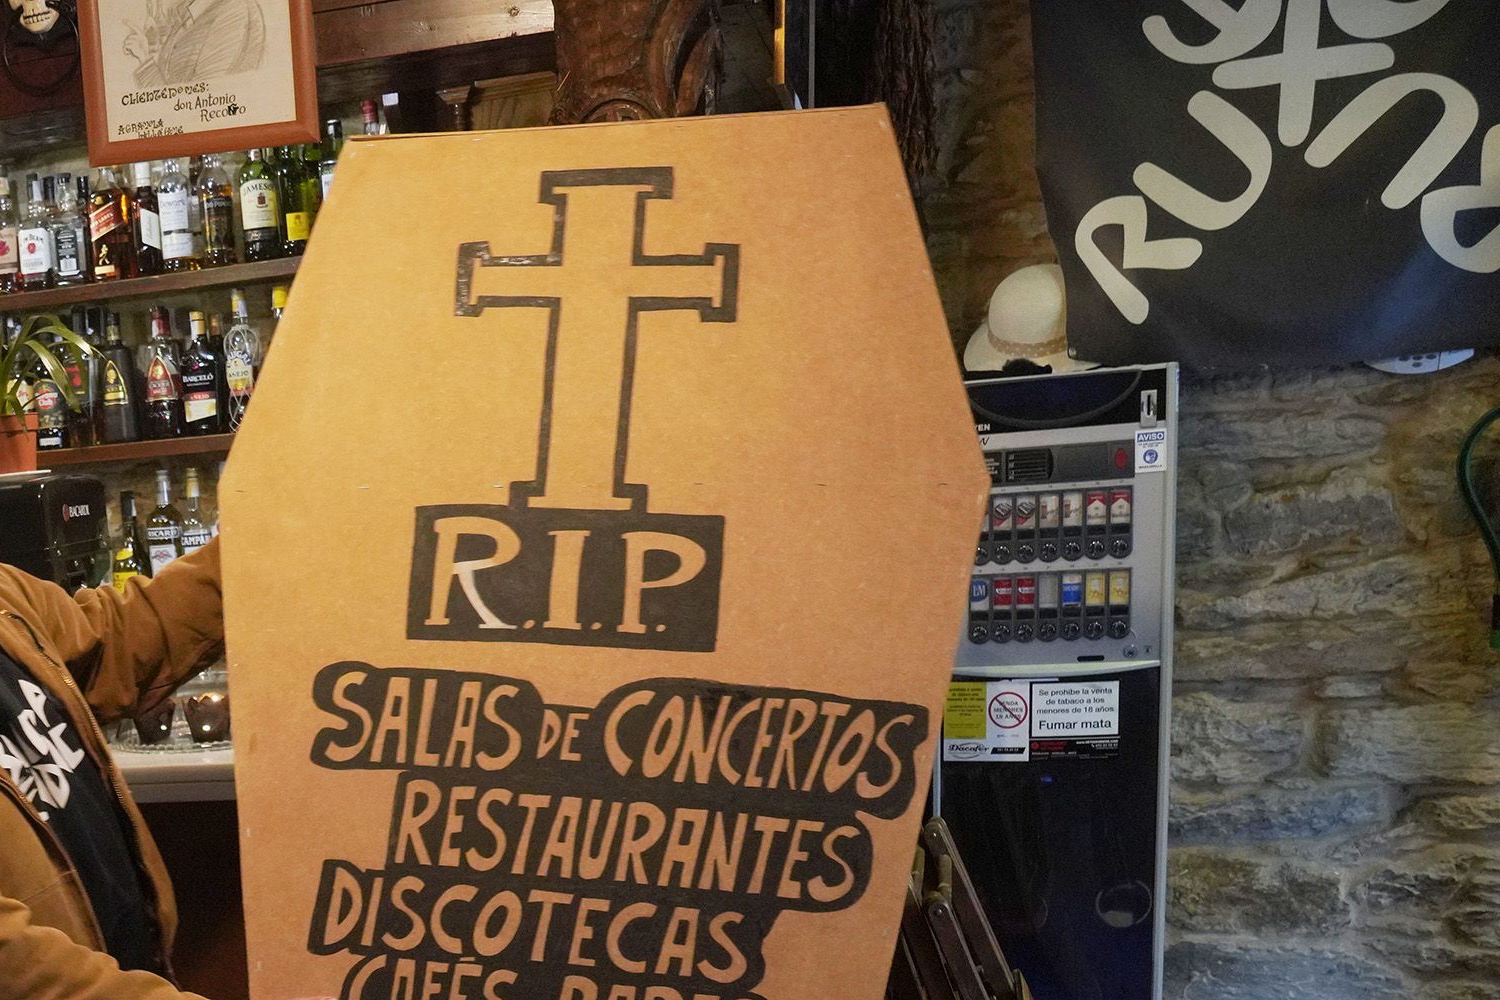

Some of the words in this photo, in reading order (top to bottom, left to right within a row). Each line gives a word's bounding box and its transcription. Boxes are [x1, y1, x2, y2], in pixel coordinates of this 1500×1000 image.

[173, 99, 192, 111] don
[194, 94, 236, 110] Antonio
[242, 181, 275, 196] JAMES
[182, 372, 214, 383] BARCELÓ
[1138, 432, 1164, 441] AVISO
[424, 515, 707, 635] R.I.P.
[1039, 720, 1077, 730] Fumar
[1081, 719, 1112, 729] mata
[324, 670, 522, 772] SALAS
[536, 711, 591, 763] DE
[604, 689, 914, 799] CONCERTOS
[395, 779, 859, 902] RESTAURANTES
[323, 864, 748, 984] DISCOTECAS
